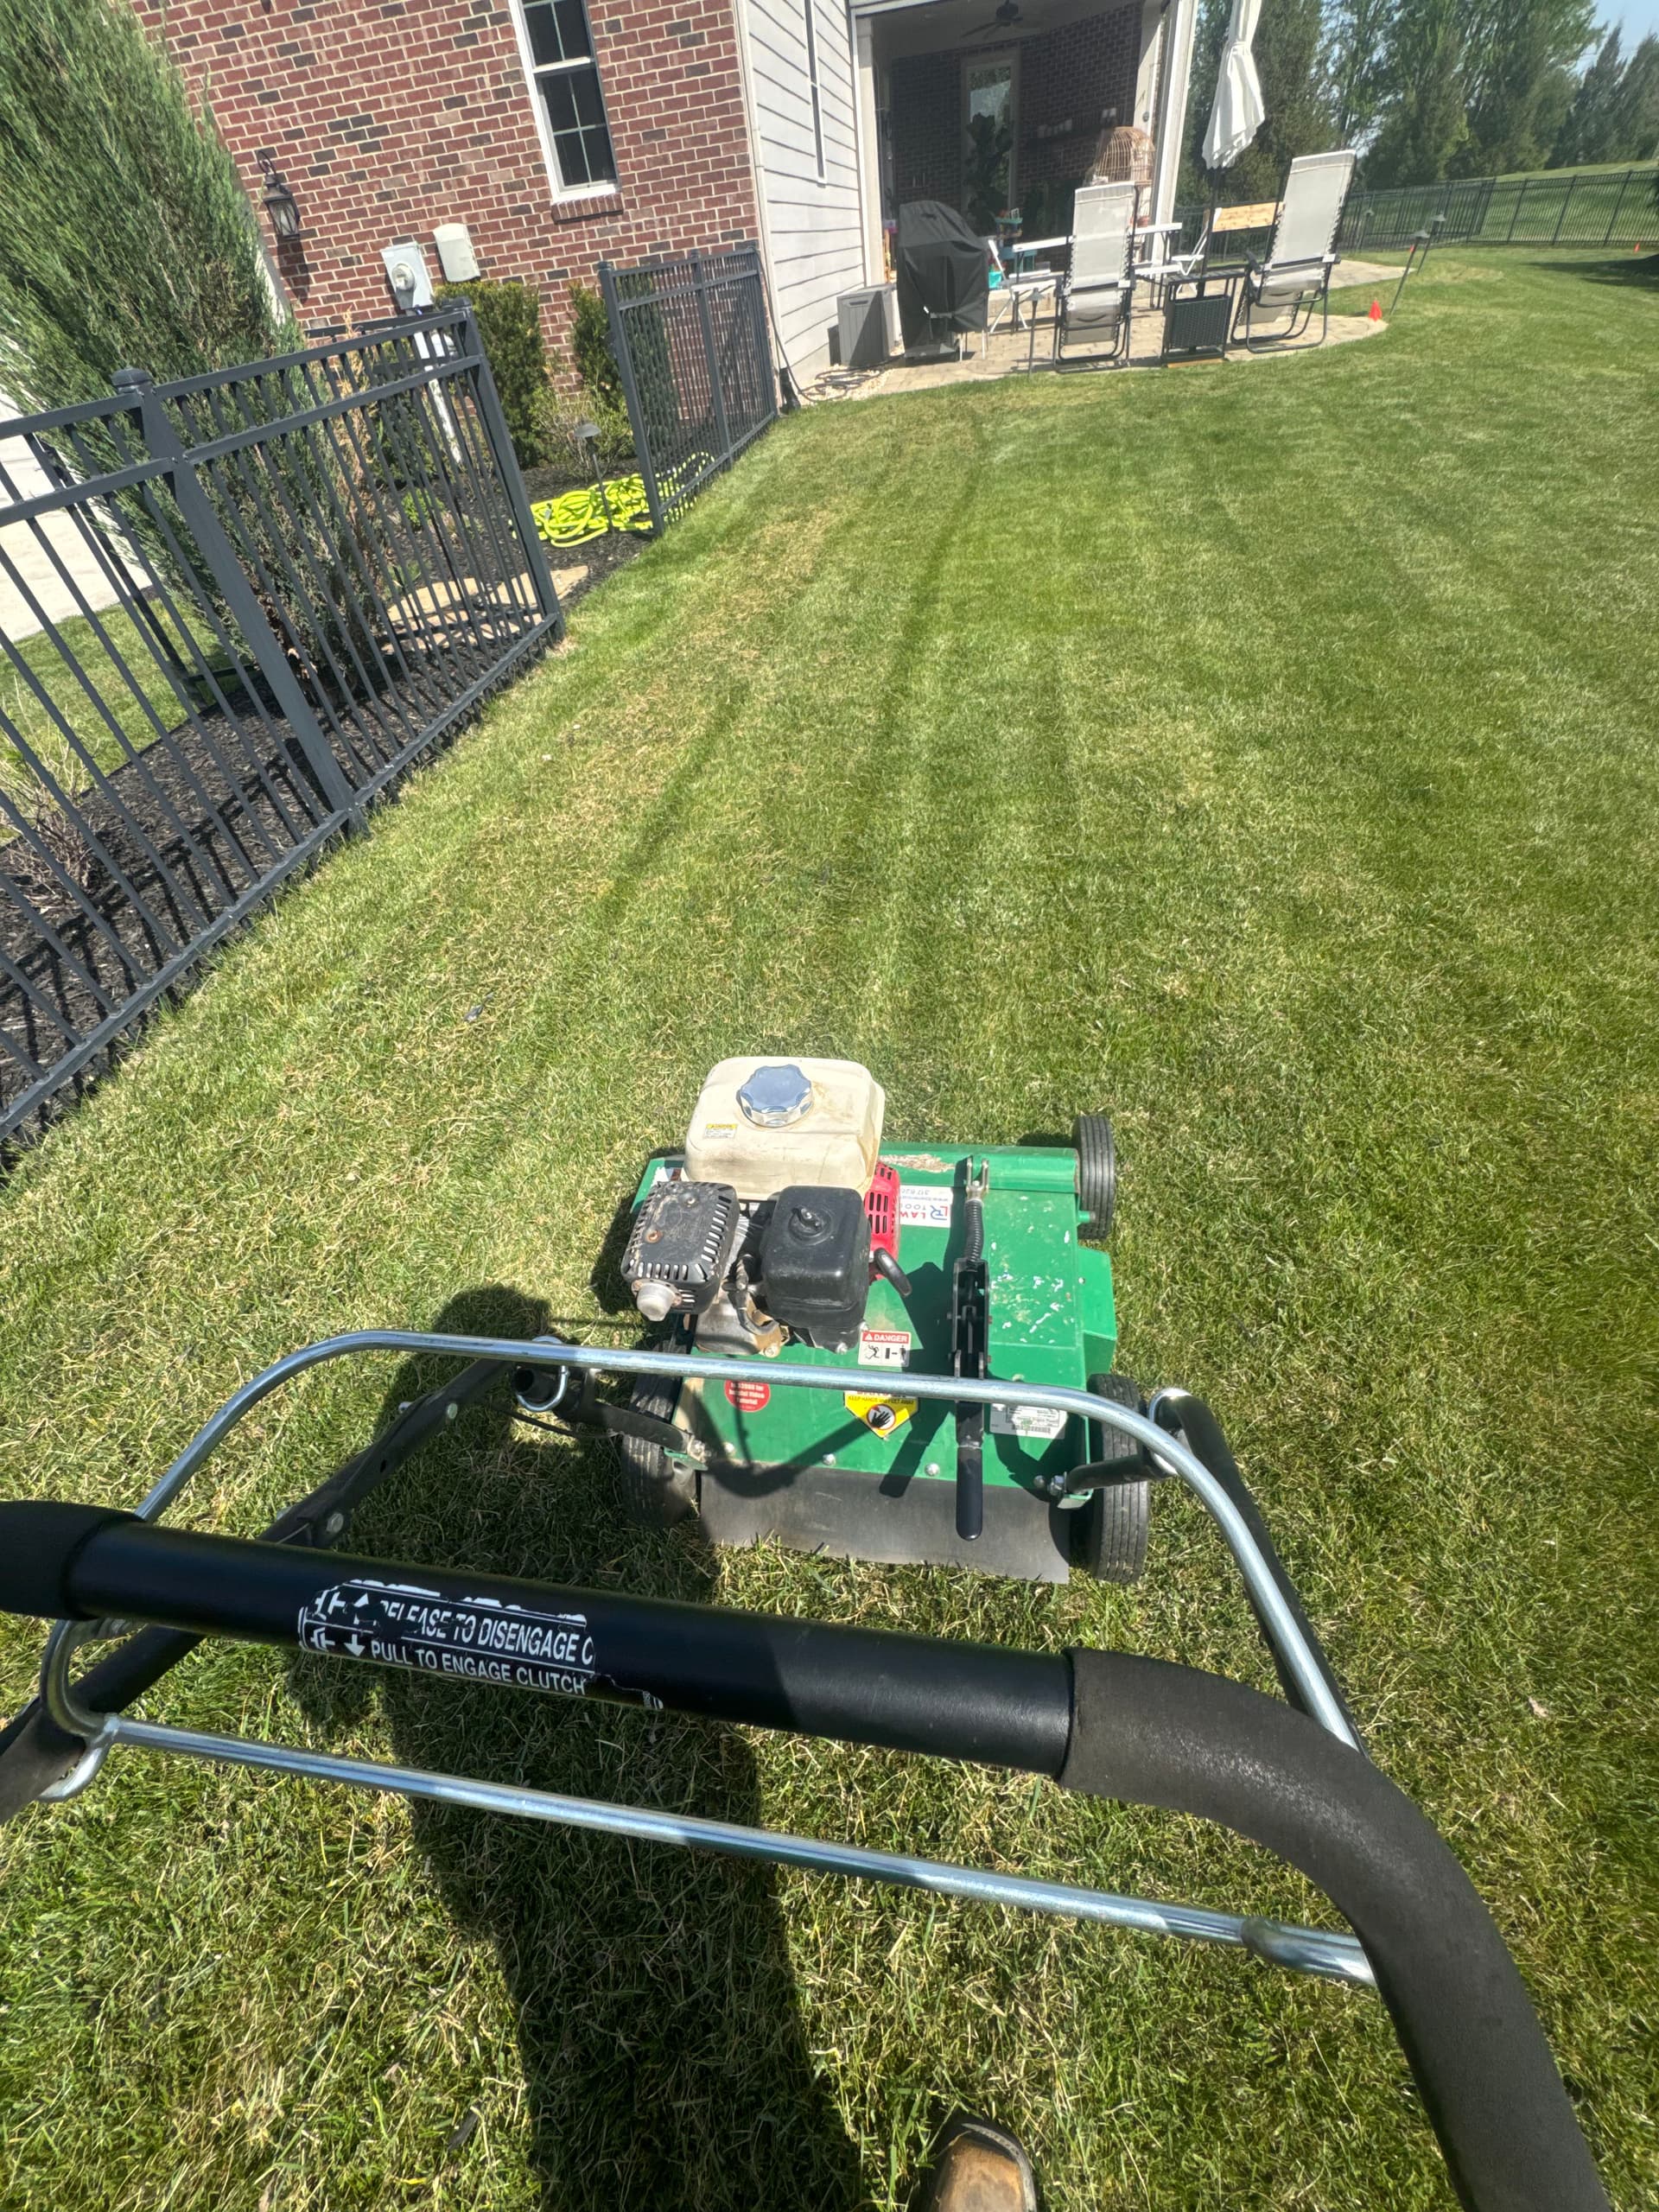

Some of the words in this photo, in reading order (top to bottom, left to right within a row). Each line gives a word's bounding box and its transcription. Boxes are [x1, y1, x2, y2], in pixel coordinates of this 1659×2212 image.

[874, 1333, 907, 1343] DANGER
[454, 1613, 477, 1643] TO
[477, 1618, 580, 1662] DISENGAGE
[371, 1639, 414, 1666] PULL
[415, 1649, 438, 1670] TO
[442, 1652, 512, 1683] ENGAGE
[516, 1667, 588, 1695] CLUTCH
